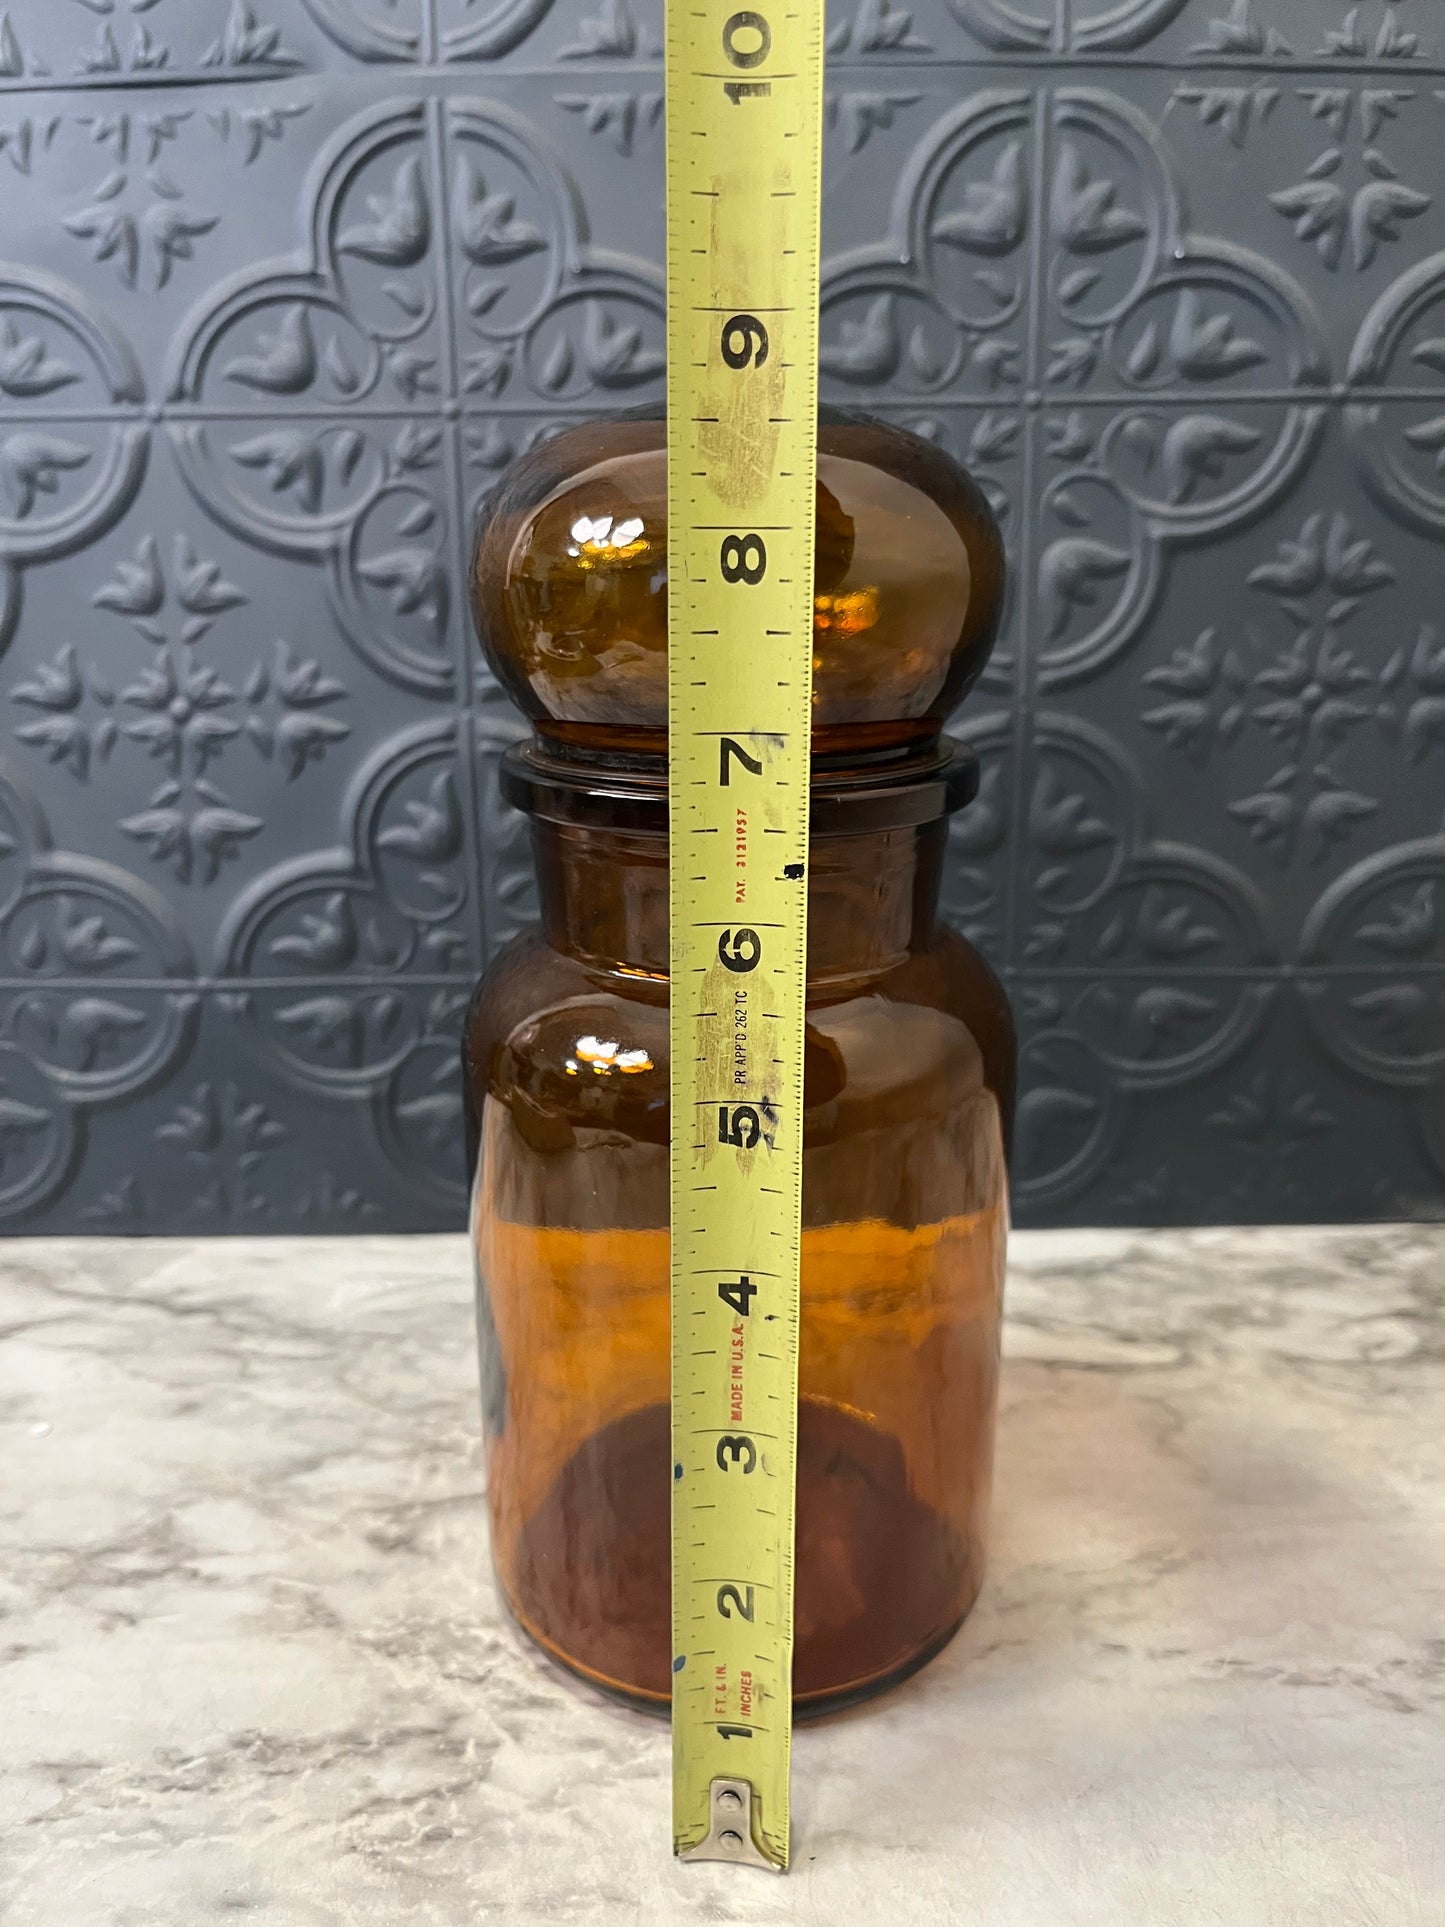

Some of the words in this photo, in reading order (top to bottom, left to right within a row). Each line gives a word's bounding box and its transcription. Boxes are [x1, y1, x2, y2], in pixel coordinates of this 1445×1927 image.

[721, 10, 772, 106] 10
[720, 314, 769, 370] 9
[720, 532, 767, 586] 8
[719, 737, 763, 787] 7
[735, 808, 747, 868] 3121957
[735, 878, 746, 904] PAT.
[718, 928, 762, 973] 6
[735, 990, 748, 1007] TC
[735, 1009, 748, 1029] 262
[735, 1033, 747, 1066] APP'D
[735, 1070, 747, 1085] PR
[718, 1105, 760, 1150] 5
[718, 1275, 758, 1317] 4
[731, 1365, 744, 1380] IN
[731, 1383, 743, 1422] MADE
[716, 1434, 757, 1475] 3
[716, 1583, 755, 1623] 2
[715, 1663, 727, 1680] IN.
[714, 1695, 727, 1714] FT.
[740, 1670, 752, 1717] INCHES
[716, 1725, 753, 1740] 1
